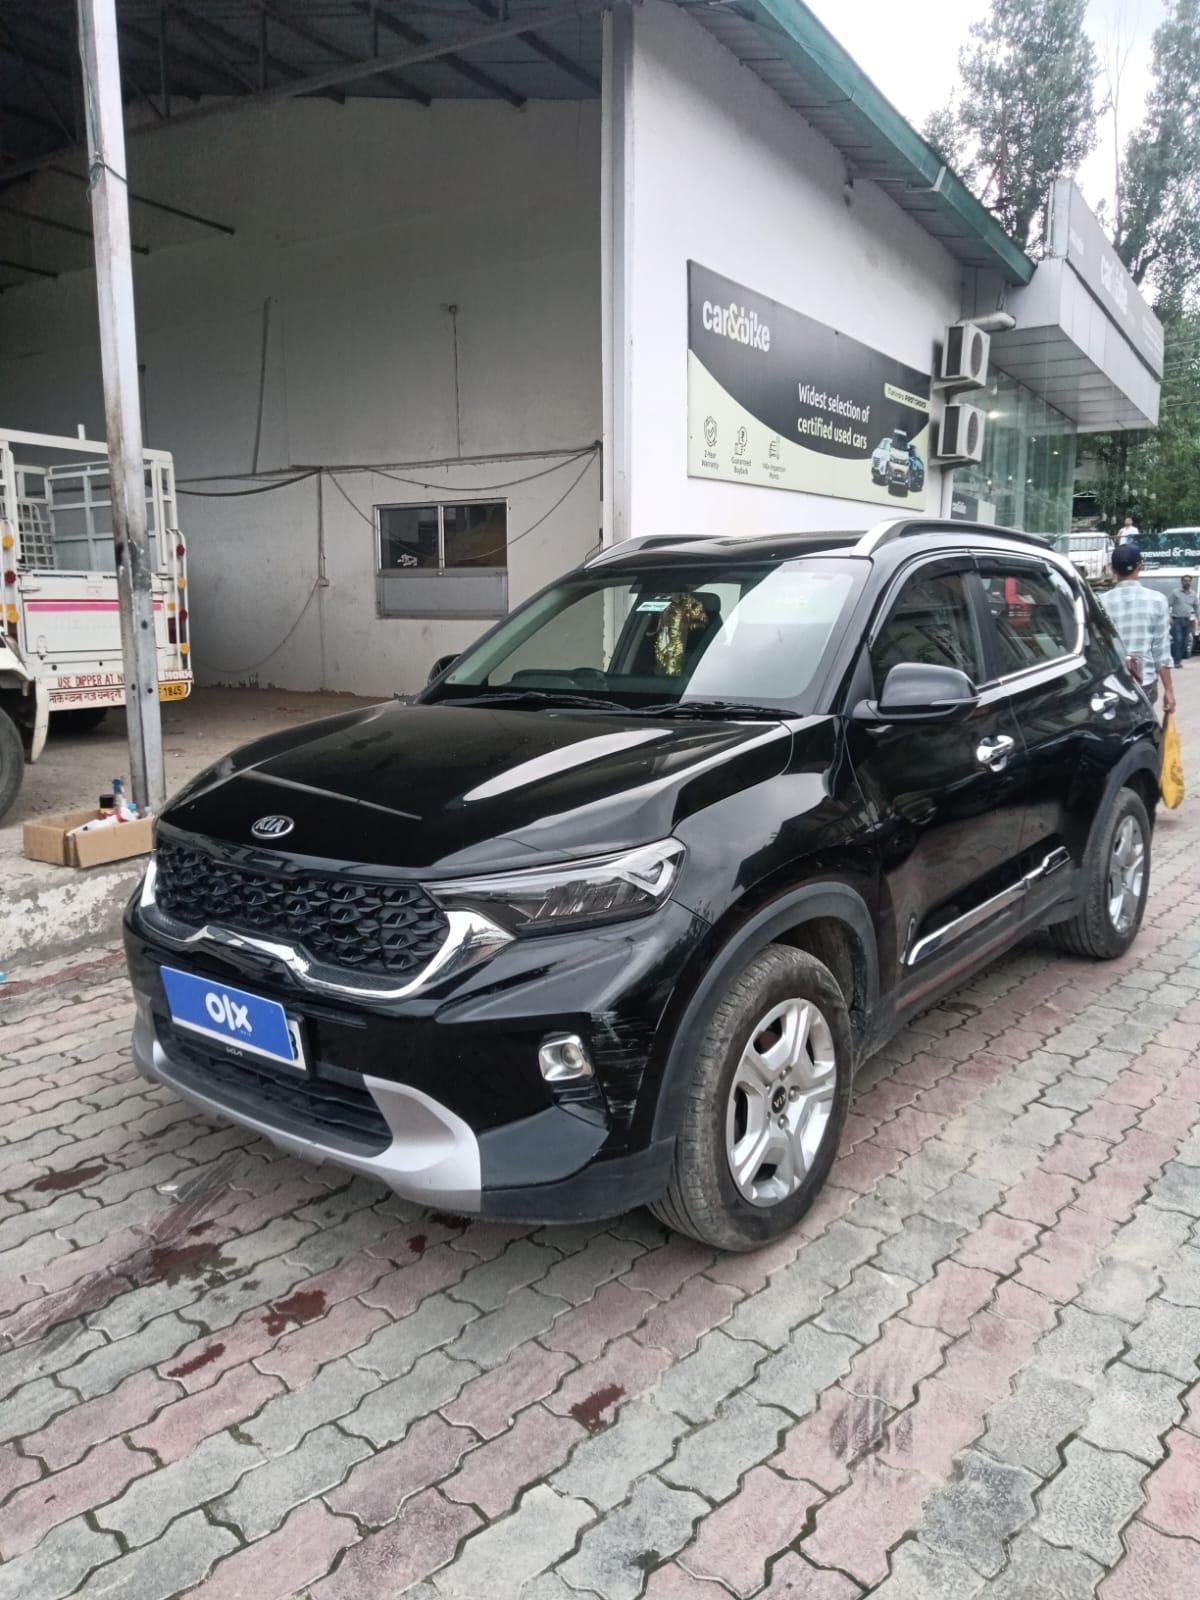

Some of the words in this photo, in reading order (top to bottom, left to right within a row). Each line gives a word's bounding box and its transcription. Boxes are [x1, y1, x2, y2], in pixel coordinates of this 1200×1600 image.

[703, 300, 770, 352] car&bike
[799, 383, 827, 410] Widest
[828, 394, 860, 420] selection
[862, 405, 870, 423] of
[798, 416, 833, 440] certified
[834, 426, 852, 445] used
[853, 433, 867, 449] cars
[1140, 549, 1171, 558] newed
[1172, 547, 1184, 557] &
[1184, 549, 1200, 557] Rea
[58, 676, 70, 688] USE
[75, 674, 102, 687] DIPPER
[105, 673, 113, 685] AT
